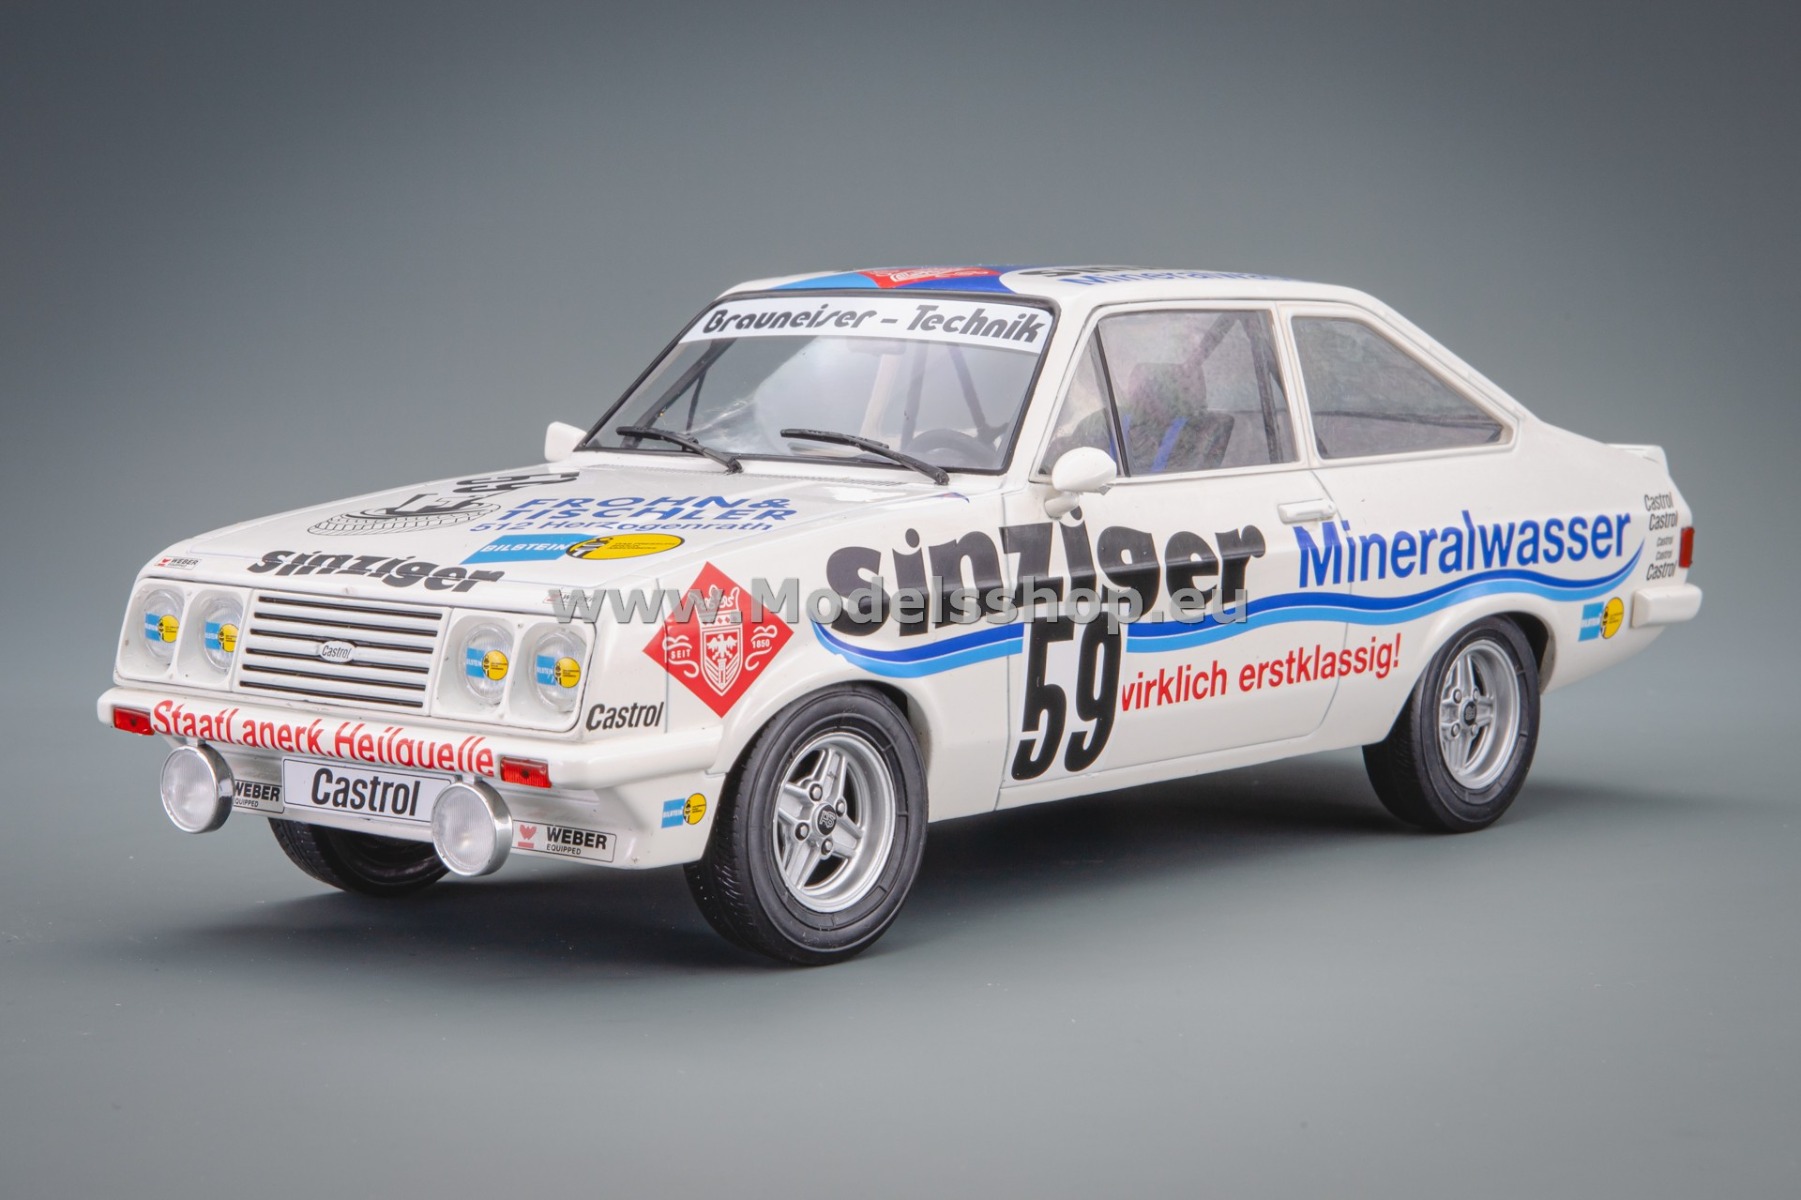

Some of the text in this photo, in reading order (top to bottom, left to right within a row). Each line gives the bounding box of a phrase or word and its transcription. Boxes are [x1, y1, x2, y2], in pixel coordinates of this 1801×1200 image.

[702, 303, 877, 333] Brauneiser
[906, 304, 1046, 343] Technik
[1644, 491, 1673, 511] Castrol
[496, 507, 797, 521] TISCHLER
[1649, 510, 1678, 531] Castrol
[469, 520, 773, 532] 512 Herzogenrath
[479, 542, 570, 552] BILSTEIN
[1294, 510, 1631, 589] Mineralwasser
[1656, 536, 1674, 548] Castrol
[1655, 550, 1672, 561] Castrol
[247, 550, 505, 592] sinziger
[826, 506, 1266, 637] sinziger
[1646, 561, 1678, 581] Castrol
[321, 644, 351, 660] Castrol
[670, 649, 691, 659] SEIT
[1239, 633, 1401, 692] erstklassig!
[1011, 610, 1124, 782] 59
[586, 701, 665, 732] Castrol
[311, 768, 421, 817] Castrol
[547, 826, 608, 850] WEBER
[546, 843, 582, 856] EQUIPPED
